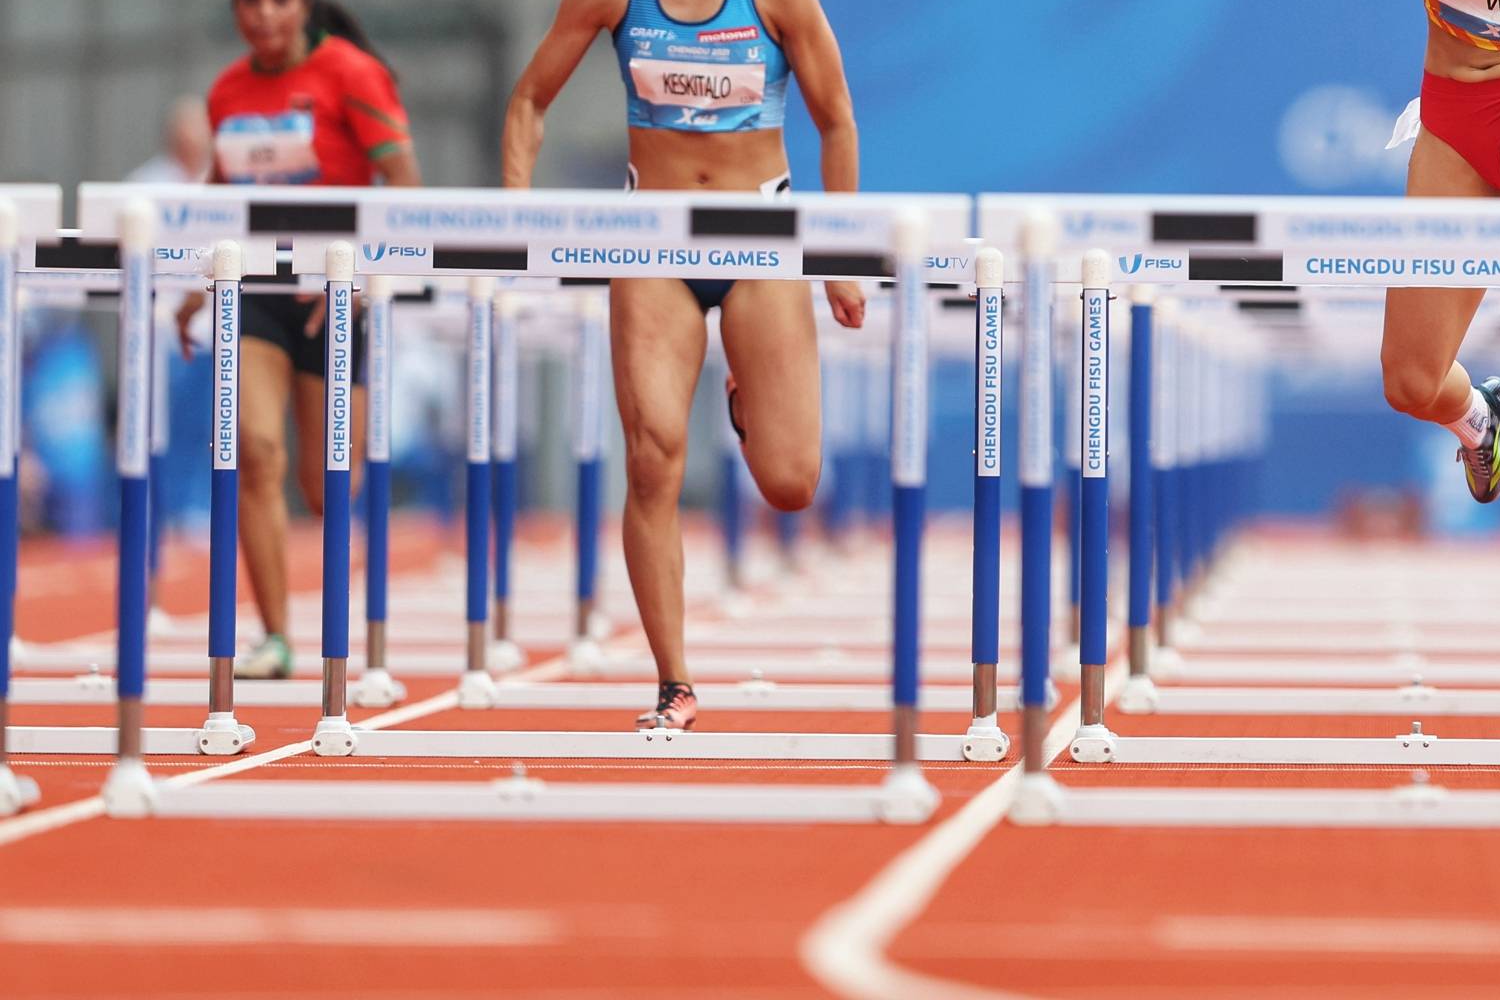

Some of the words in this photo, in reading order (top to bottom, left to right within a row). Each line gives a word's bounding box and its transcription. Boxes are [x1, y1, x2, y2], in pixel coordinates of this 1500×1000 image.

[699, 28, 757, 42] motonet
[662, 73, 732, 100] KESKITALO
[388, 246, 427, 257] FISU
[551, 247, 652, 266] CHENGDU
[656, 248, 701, 266] FISU
[708, 249, 781, 267] GAMES
[1144, 258, 1182, 270] FISU
[1306, 257, 1406, 276] CHENGDU
[1411, 258, 1456, 276] FISU
[220, 289, 233, 343] GAMES
[333, 289, 347, 343] GAMES
[984, 296, 998, 350] GAMES
[1088, 297, 1101, 351] GAMES
[220, 349, 233, 382] FISU
[333, 349, 347, 382] FISU
[984, 356, 998, 389] FISU
[1088, 357, 1101, 390] FISU
[220, 387, 233, 462] CHENGDU
[333, 387, 347, 462] CHENGDU
[984, 394, 998, 469] CHENGDU
[1088, 395, 1101, 470] CHENGDU
